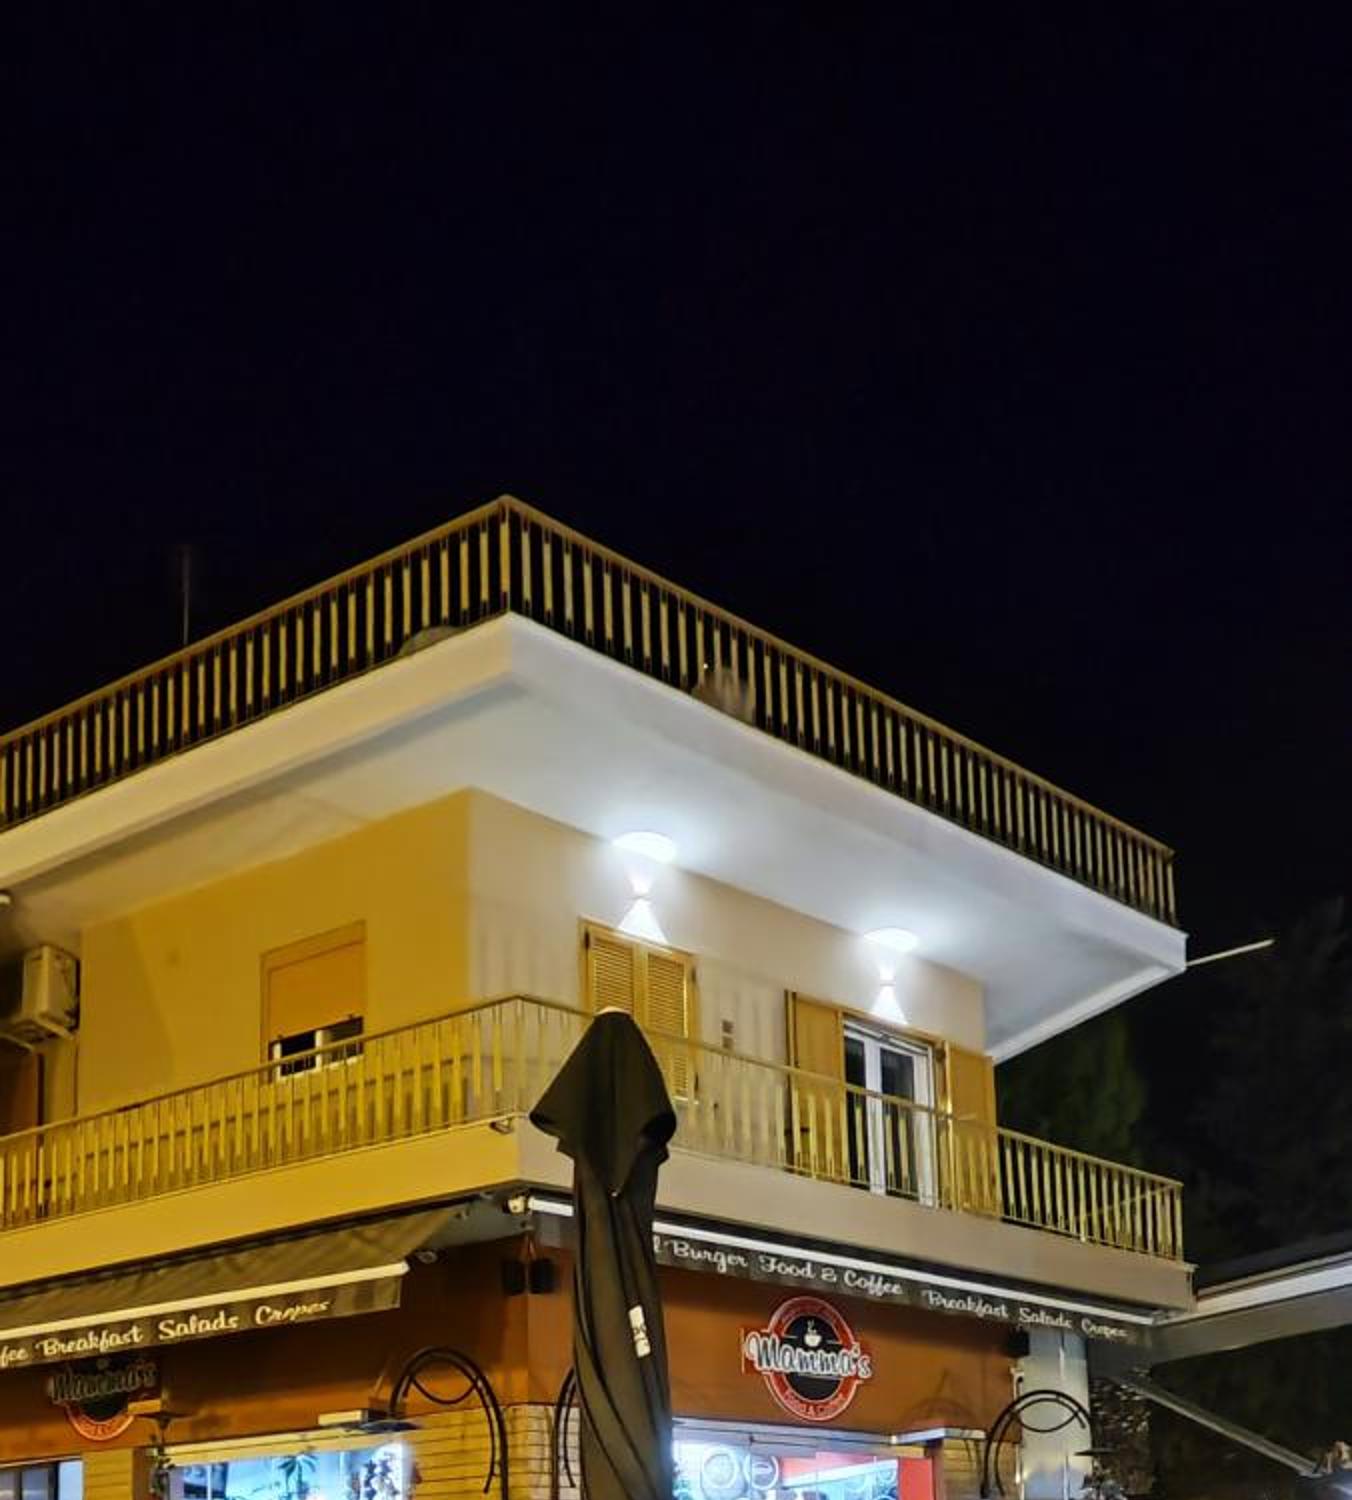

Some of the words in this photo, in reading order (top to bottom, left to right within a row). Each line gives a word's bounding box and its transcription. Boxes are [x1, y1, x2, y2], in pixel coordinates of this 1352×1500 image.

[665, 1239, 748, 1273] Burger
[759, 1254, 817, 1279] Food
[821, 1269, 837, 1283] &
[843, 1268, 903, 1297] Coffee
[922, 1288, 1009, 1319] Breakfast
[1018, 1307, 1073, 1329] Salads
[1081, 1317, 1128, 1339] Crepes
[35, 1325, 144, 1358] Breakfast
[158, 1310, 240, 1341] Salads
[255, 1299, 330, 1326] Crepes
[745, 1331, 872, 1379] Mamma's
